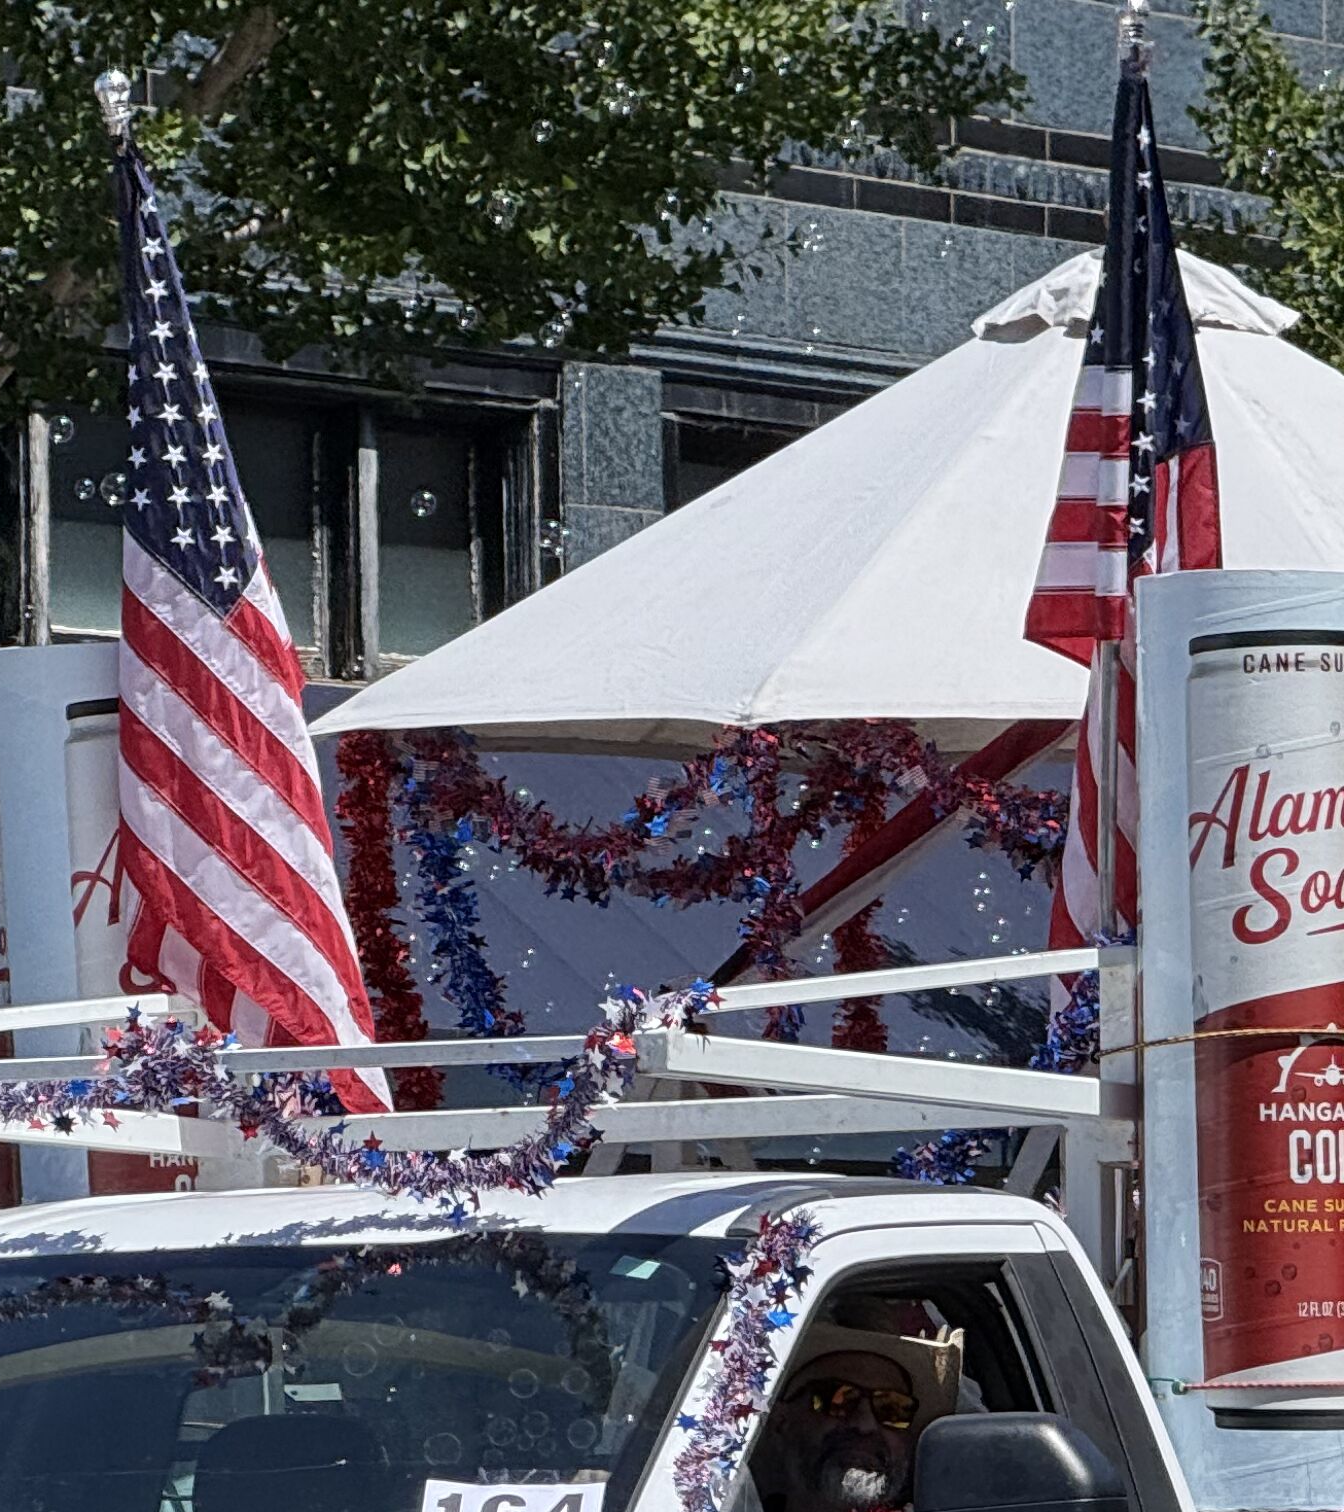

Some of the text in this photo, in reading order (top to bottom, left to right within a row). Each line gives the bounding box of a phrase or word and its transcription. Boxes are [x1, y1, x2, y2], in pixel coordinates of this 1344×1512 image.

[1243, 652, 1306, 674] CANE
[1264, 1198, 1318, 1214] CANE
[1242, 1218, 1335, 1234] NATURAL
